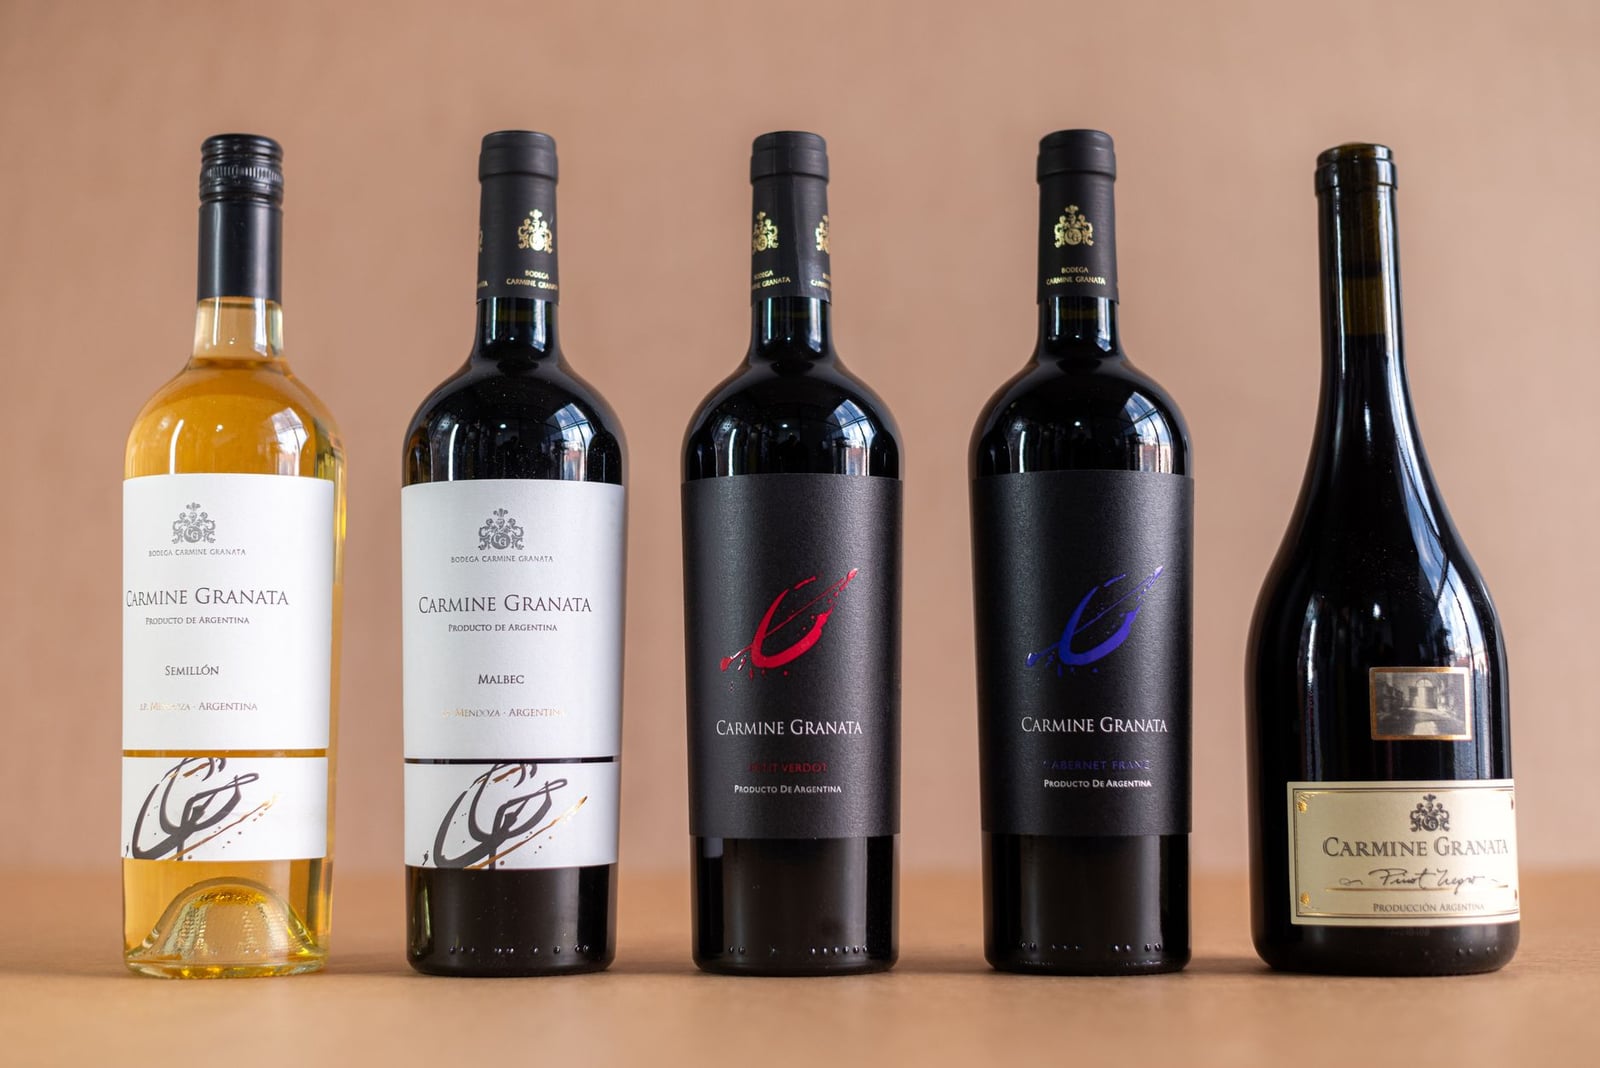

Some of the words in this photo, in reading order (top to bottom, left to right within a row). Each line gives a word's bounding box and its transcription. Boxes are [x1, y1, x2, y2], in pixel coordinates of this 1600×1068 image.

[525, 269, 550, 281] BODEGA
[1061, 266, 1088, 274] BODEGA
[506, 277, 537, 288] CARMINE
[1046, 276, 1074, 286] CARMINE
[1075, 275, 1106, 286] GRANATA
[148, 549, 173, 557] BODEGA
[175, 548, 208, 556] CARMINE
[210, 548, 247, 556] GRANATA
[451, 555, 480, 563] BODEGA
[482, 555, 516, 563] CARMINE
[518, 555, 554, 563] GRANATA
[126, 589, 188, 607] CARMINE
[195, 587, 290, 606] GRANATA
[418, 595, 497, 614] CARMINE
[504, 594, 592, 613] GRANATA
[145, 616, 184, 626] PRODUCTO
[186, 617, 197, 625] DE
[199, 615, 250, 625] ARGENTINA
[448, 623, 493, 632] PRODUCTO
[495, 624, 506, 632] DE
[508, 623, 558, 632] ARGENTINA
[164, 663, 220, 677] SEMILLÓN
[478, 673, 525, 685] MALBEC
[198, 702, 258, 711] ARGENTINA
[455, 708, 501, 718] MENDOZA
[716, 719, 785, 736] CARMINE
[790, 718, 863, 736] GRANATA
[1021, 716, 1094, 733] CARMINE
[1099, 716, 1168, 733] GRANATA
[780, 761, 828, 773] VERDOT
[734, 784, 778, 793] PRODUCTO
[780, 784, 793, 793] DE
[794, 784, 842, 793] ARGENTINA
[1043, 779, 1090, 788] PRODUCTO
[1092, 779, 1105, 788] DE
[1106, 779, 1152, 788] ARGENTINA
[1322, 836, 1428, 858] CARMINE
[1433, 835, 1509, 857] GRANATA
[1368, 867, 1436, 889] Pinot
[1372, 901, 1437, 913] PRODUCCIÓN
[1439, 902, 1485, 912] ARGENTINA
